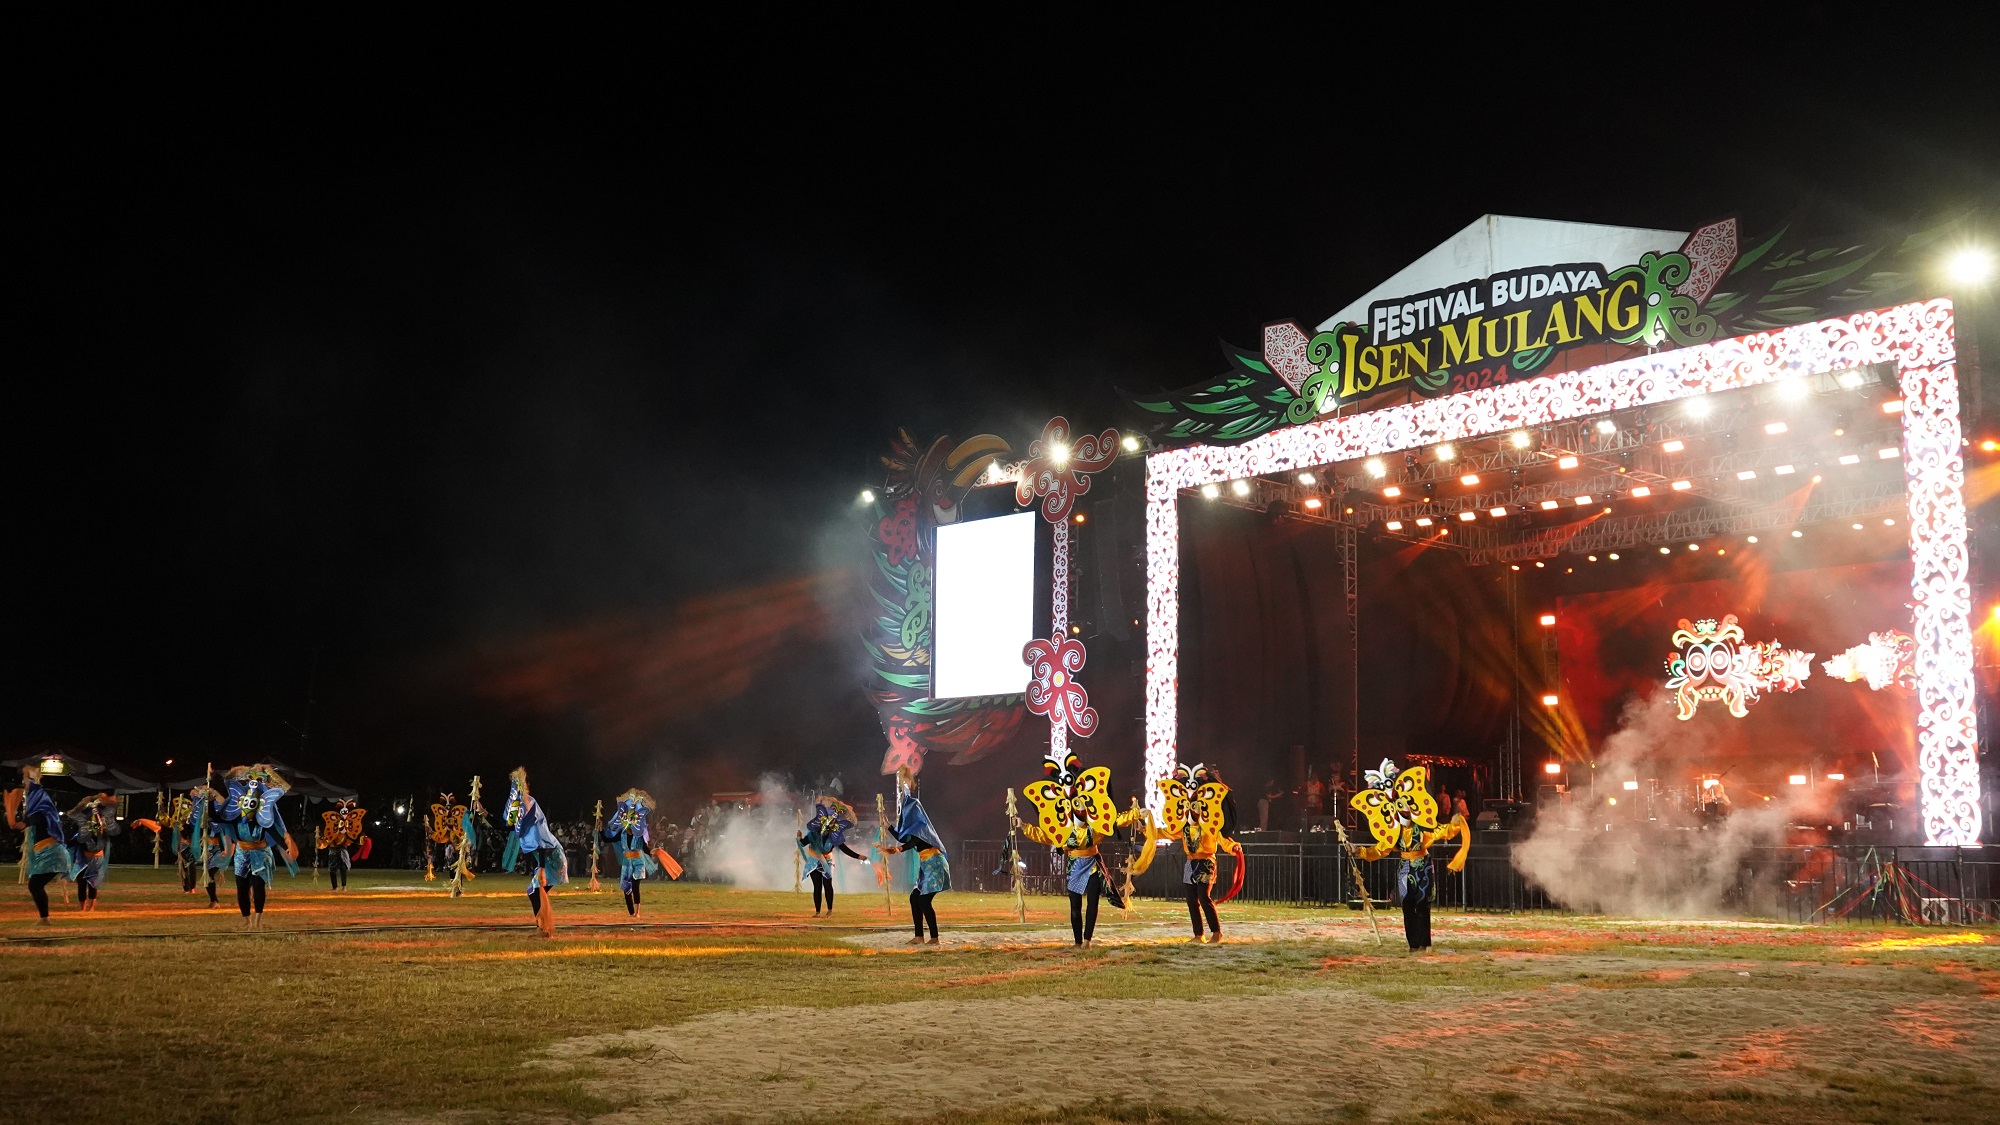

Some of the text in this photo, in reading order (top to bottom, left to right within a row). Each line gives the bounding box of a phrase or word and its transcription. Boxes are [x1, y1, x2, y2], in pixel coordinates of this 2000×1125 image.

[1339, 280, 1641, 398] ISEN MULANG
[1373, 270, 1603, 345] FESTIVAL BUDAYA
[1452, 364, 1509, 393] 2024
